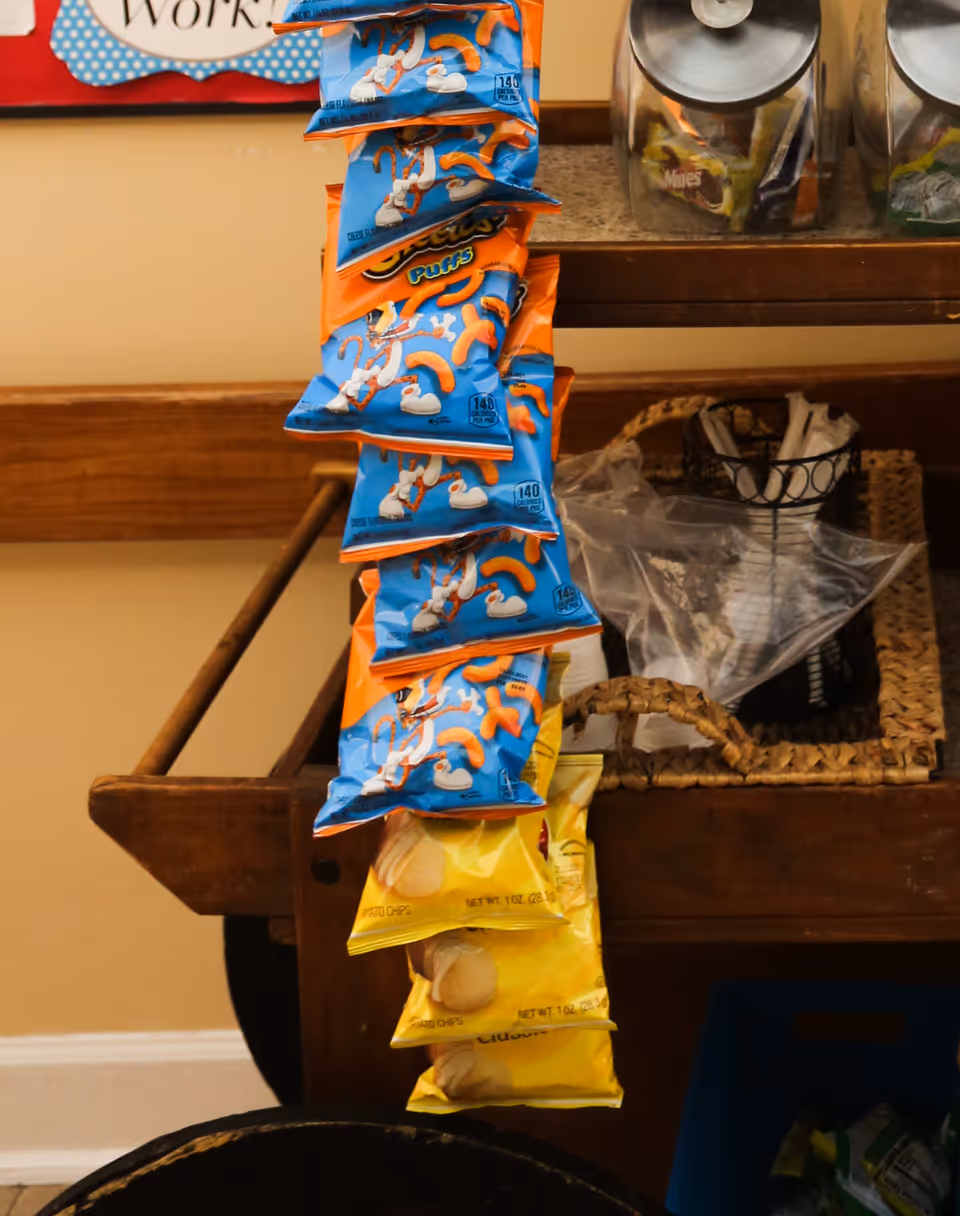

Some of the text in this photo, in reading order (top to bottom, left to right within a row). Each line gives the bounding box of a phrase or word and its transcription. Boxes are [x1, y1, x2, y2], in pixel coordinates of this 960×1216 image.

[499, 75, 520, 89] 140
[407, 246, 474, 285] Puffs
[473, 396, 494, 410] 140
[519, 483, 540, 499] 140
[466, 898, 483, 908] NET
[387, 904, 413, 917] CHIPS
[517, 1008, 536, 1020] NET
[437, 1016, 464, 1028] CHIPS
